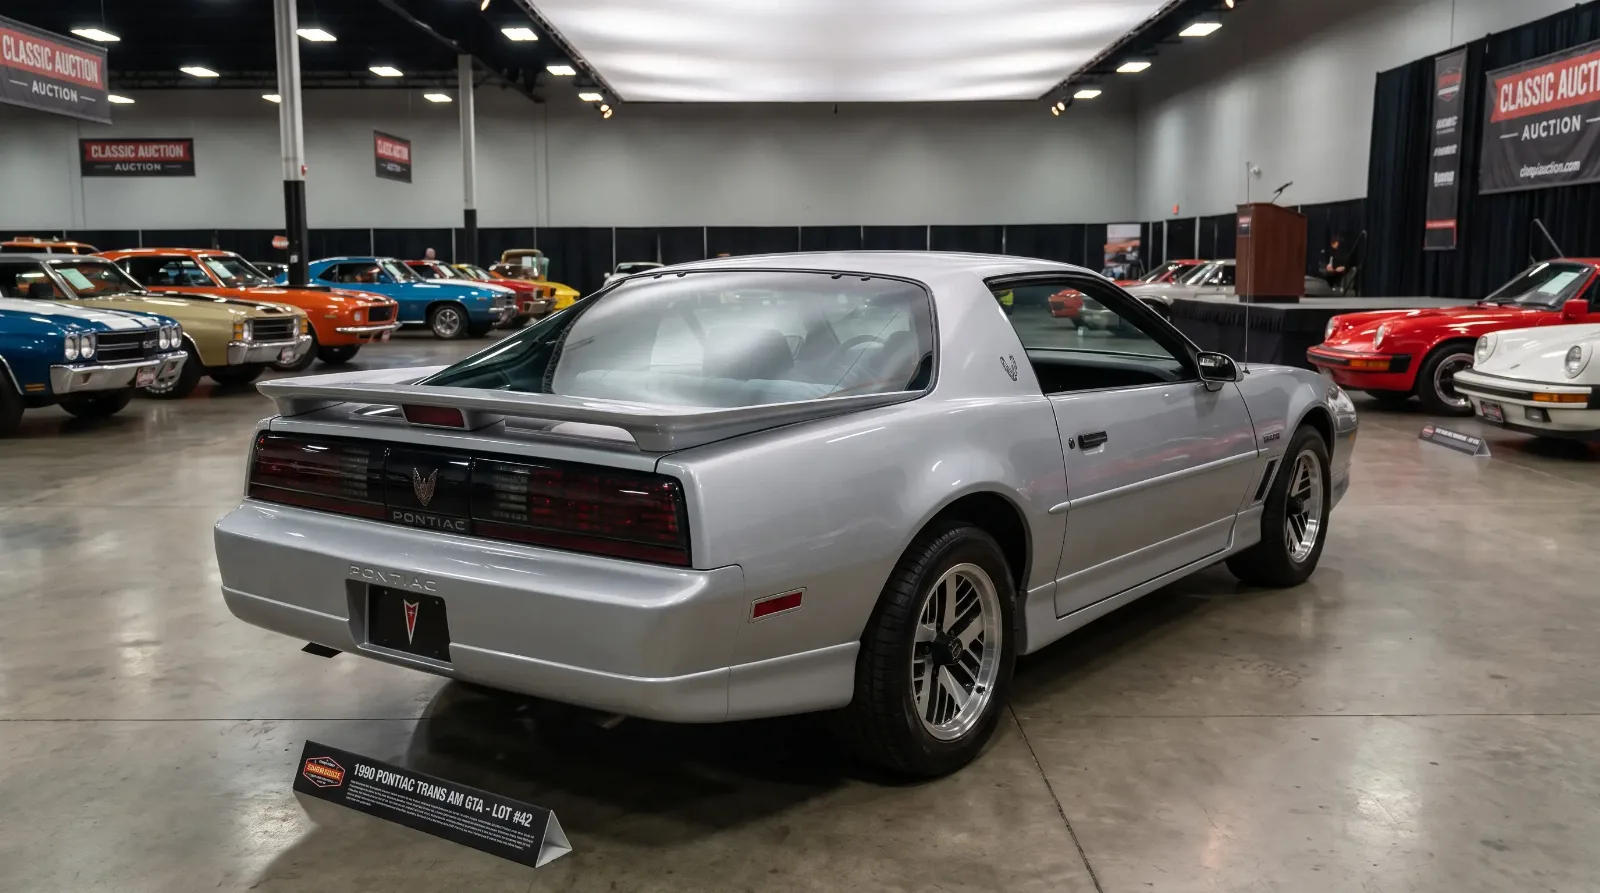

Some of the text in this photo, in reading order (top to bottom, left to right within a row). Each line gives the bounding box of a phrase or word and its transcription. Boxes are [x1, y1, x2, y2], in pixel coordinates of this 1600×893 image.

[2, 34, 98, 83] CLASSIC AUCTION
[31, 80, 78, 102] AUCTION
[1500, 71, 1555, 113] CLASSIC
[1521, 114, 1582, 141] AUCTION
[91, 144, 183, 158] CLASSIC AUCTION
[114, 163, 162, 172] AUCTION
[393, 511, 466, 531] PONTIAC
[349, 565, 437, 592] PONTIAC
[353, 763, 376, 780] 1990
[376, 769, 416, 792] PONTIAC
[416, 780, 447, 802] TRANS
[446, 790, 465, 807] AM
[464, 795, 484, 813] GTA
[491, 803, 513, 821] LOT
[512, 810, 533, 828] #42
